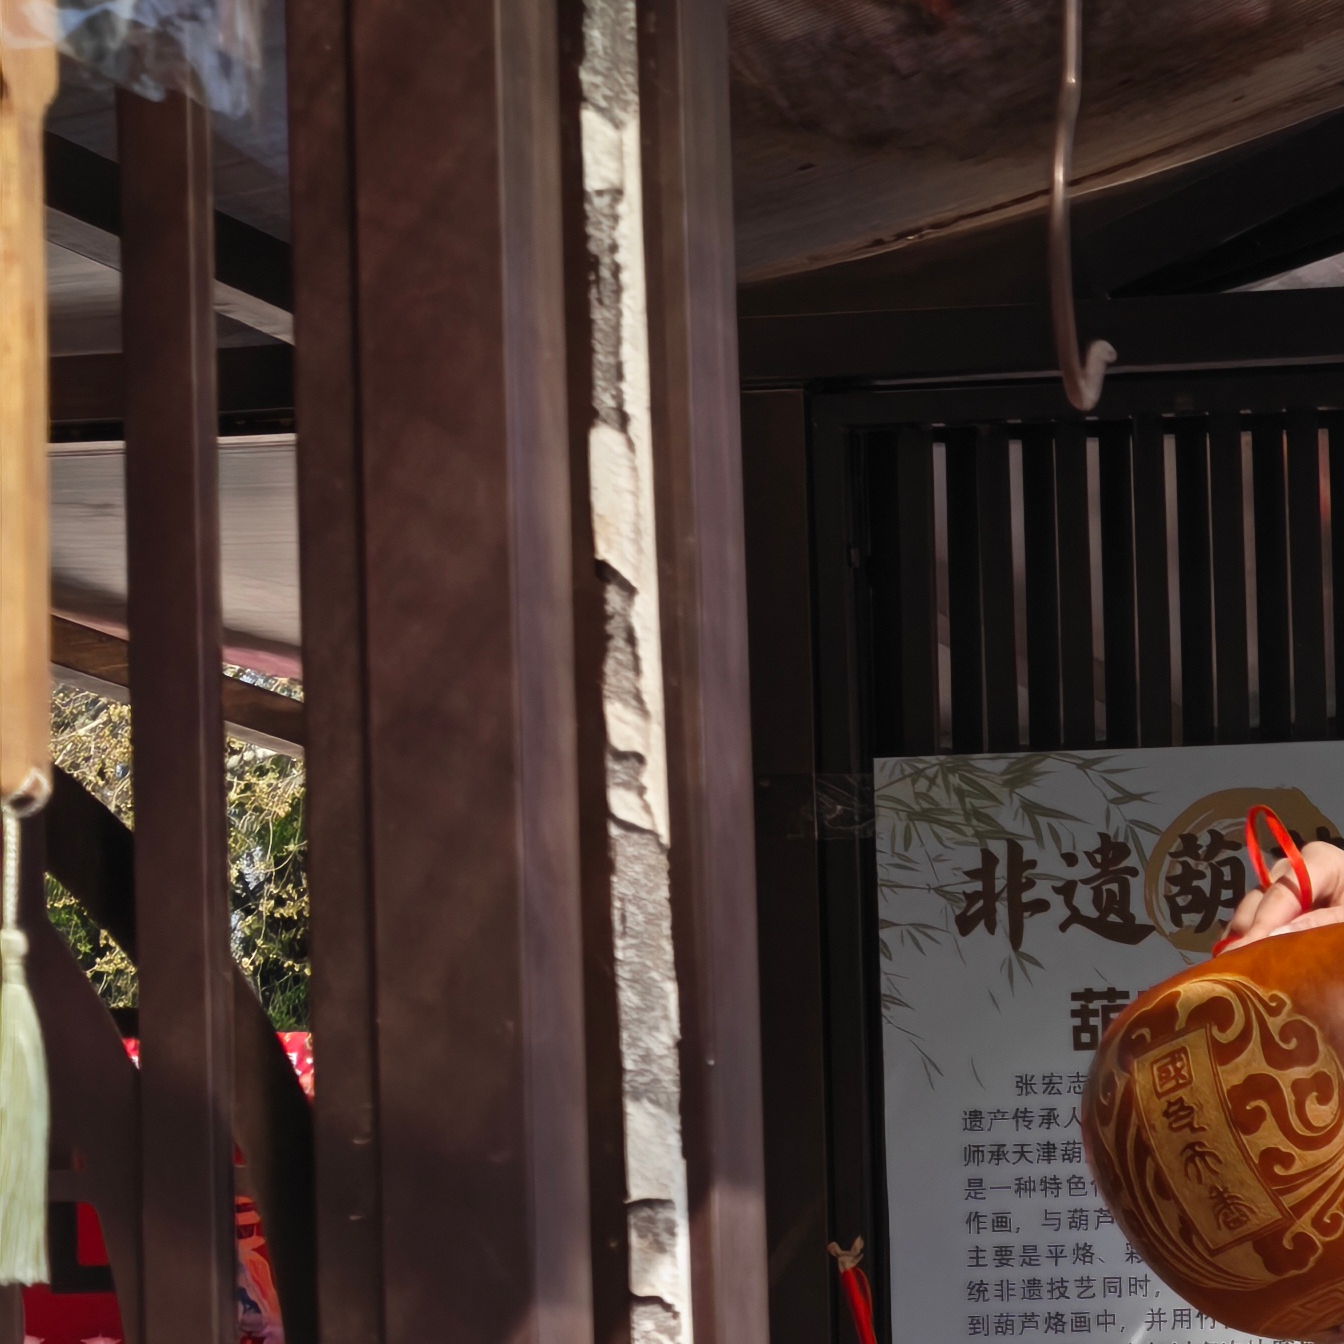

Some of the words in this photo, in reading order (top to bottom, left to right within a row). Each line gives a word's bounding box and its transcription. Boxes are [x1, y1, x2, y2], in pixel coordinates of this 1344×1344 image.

[962, 1107, 1084, 1133] 遗产传承人
[964, 1175, 1101, 1201] 是一种特色
